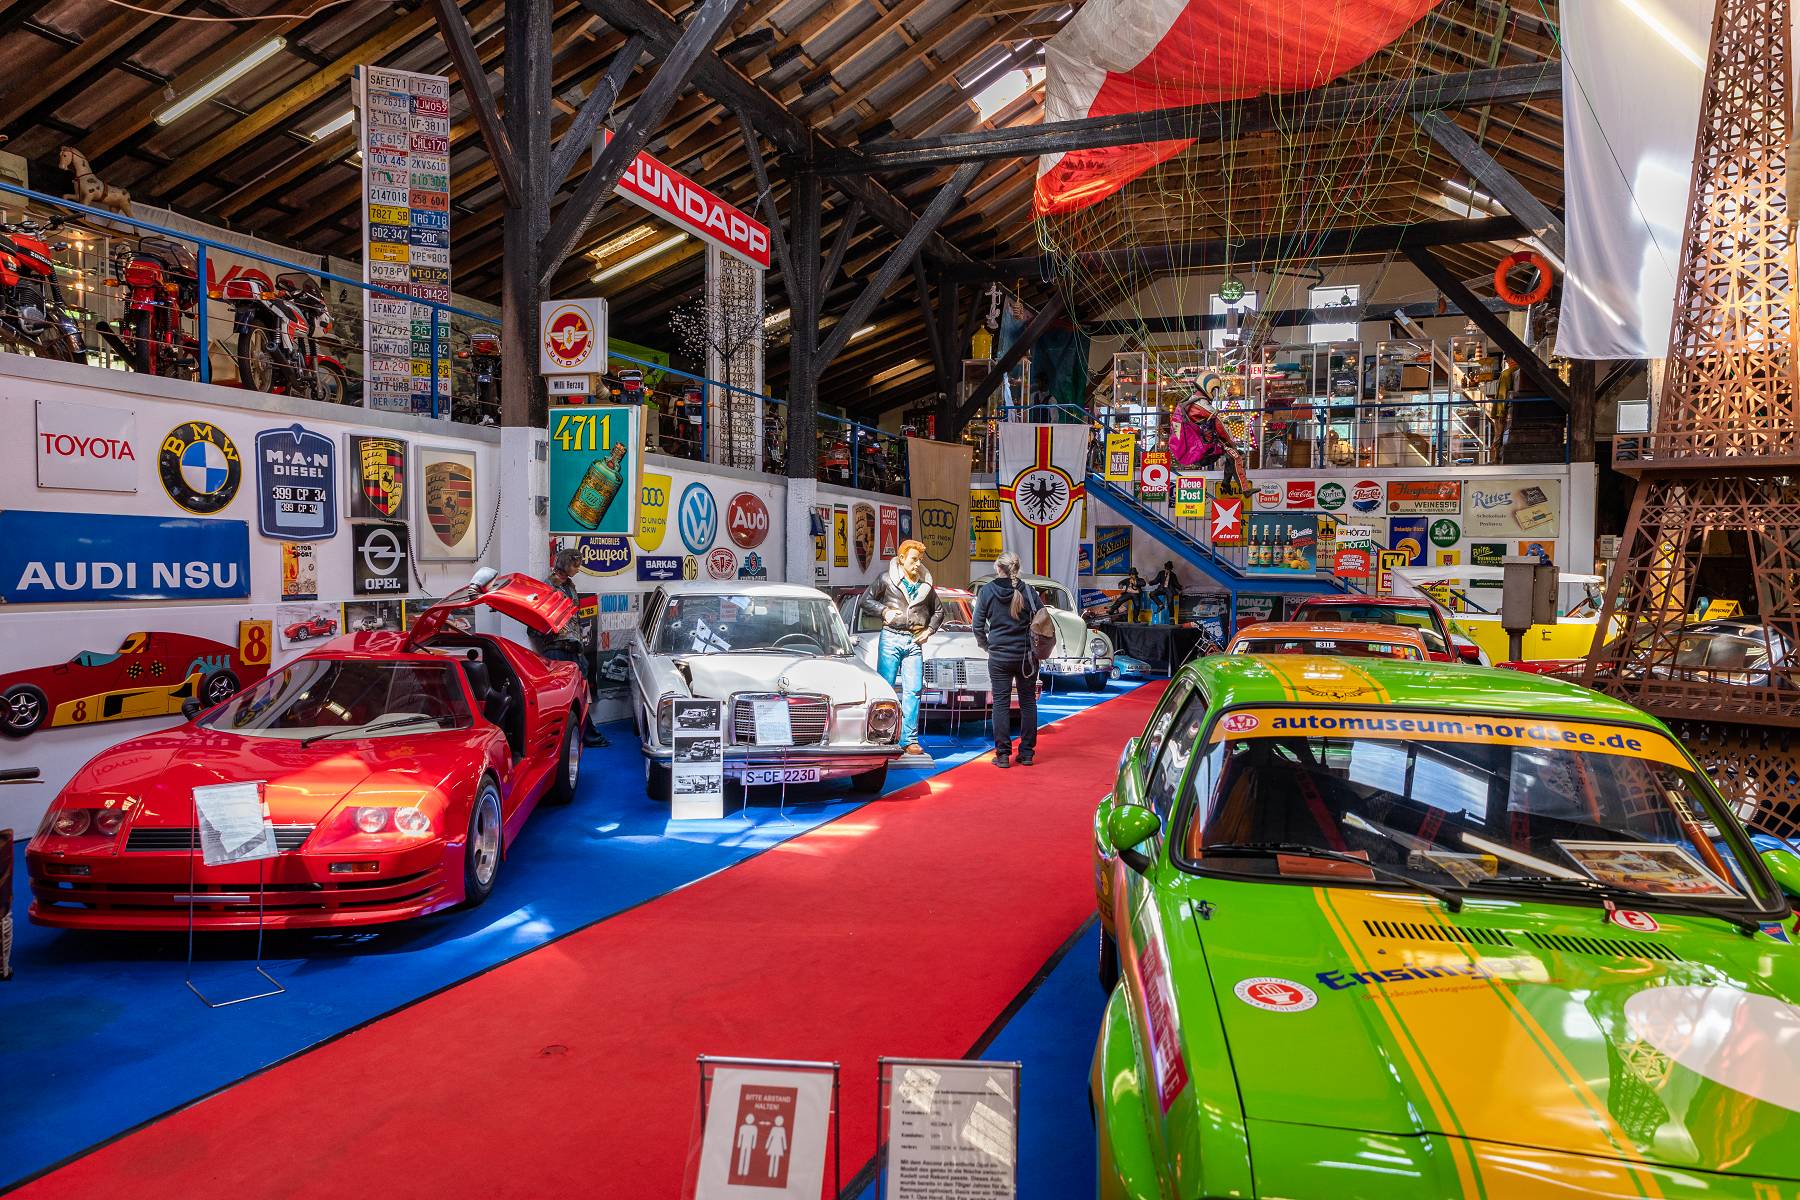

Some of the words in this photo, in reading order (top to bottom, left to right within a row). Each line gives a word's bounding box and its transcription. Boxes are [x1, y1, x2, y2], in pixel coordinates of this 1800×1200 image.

[432, 290, 448, 300] 422
[566, 380, 584, 390] Herzog
[553, 414, 612, 452] 4711
[40, 433, 136, 461] TOYOTA
[163, 423, 239, 462] BMW
[1112, 454, 1129, 464] NEUE
[274, 464, 324, 478] DIESEL
[1111, 464, 1128, 472] BLATT
[1143, 464, 1169, 486] Q
[1180, 479, 1201, 488] Neue
[272, 487, 292, 500] 399
[296, 488, 309, 500] CP
[314, 488, 326, 502] 34
[1180, 490, 1200, 500] Post
[1321, 490, 1341, 498] Sprite
[1472, 491, 1512, 509] Ritter
[281, 503, 294, 512] 399
[298, 503, 307, 513] CP
[882, 510, 897, 518] LLOYD
[648, 517, 666, 525] UNION
[732, 506, 767, 530] Audi
[580, 544, 628, 566] Peugeot
[1384, 555, 1404, 568] TV
[646, 560, 677, 568] BARKAS
[684, 557, 697, 579] MG
[16, 562, 136, 590] AUDI
[152, 561, 237, 588] NSU
[365, 578, 400, 589] OPEL
[242, 628, 268, 662] 8
[1045, 664, 1057, 672] AA
[71, 700, 86, 722] 8
[1272, 714, 1643, 752] automuseum-nordsee.de
[746, 771, 783, 784] S-CE
[784, 770, 816, 781] 2230
[1622, 911, 1644, 925] E
[764, 1095, 791, 1103] ABSTAND
